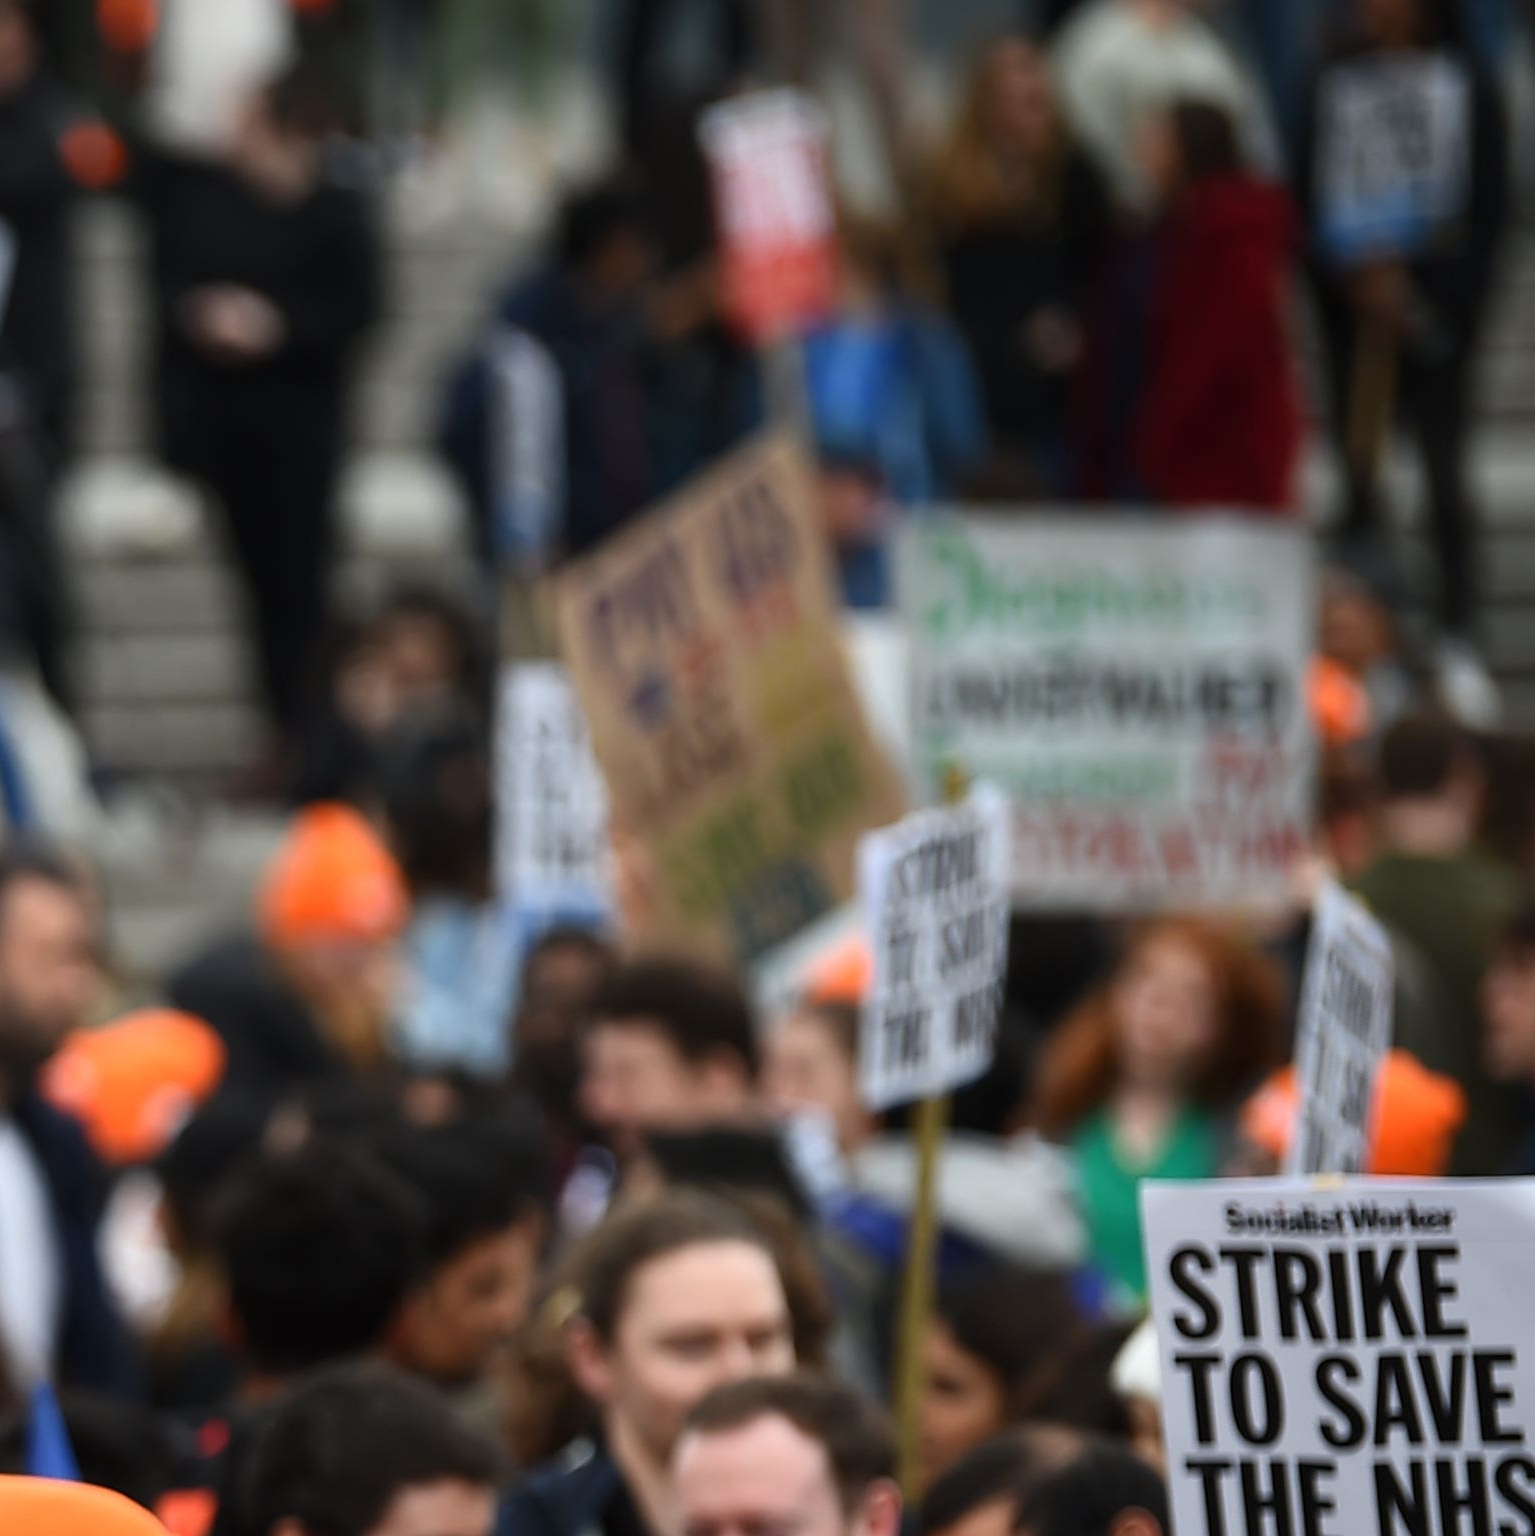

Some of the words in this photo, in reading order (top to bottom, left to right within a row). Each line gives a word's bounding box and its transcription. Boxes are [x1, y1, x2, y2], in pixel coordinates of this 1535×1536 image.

[1226, 1203, 1349, 1236] Socialist
[1350, 1203, 1455, 1235] Worker
[1168, 1246, 1469, 1343] STRIKE
[1174, 1351, 1287, 1447] TO
[1315, 1351, 1526, 1450] SAVE
